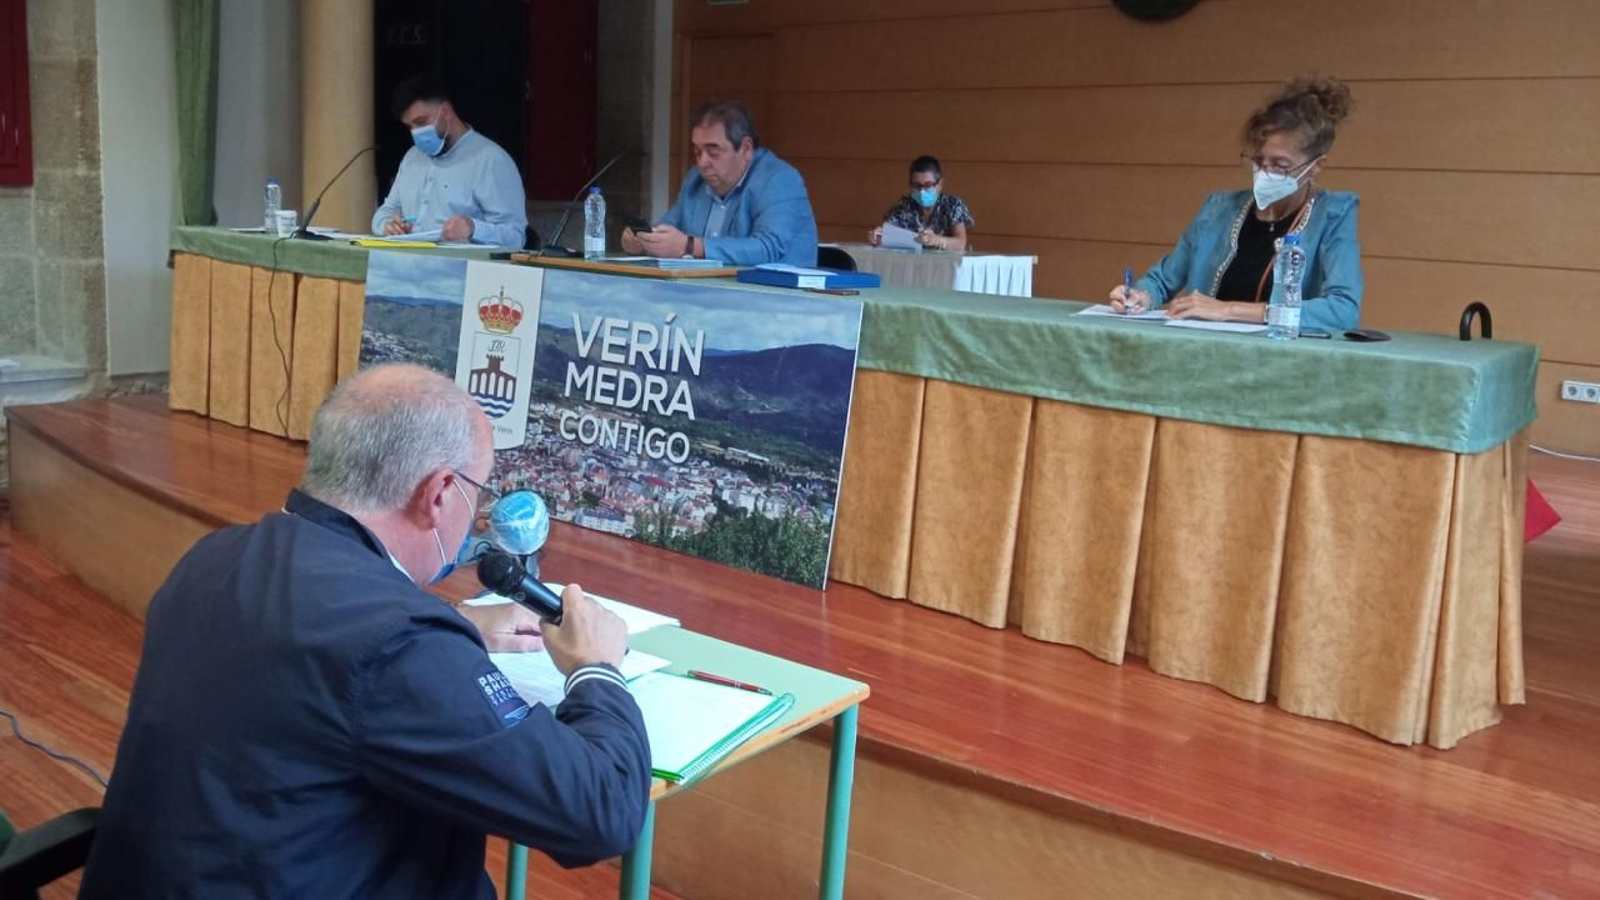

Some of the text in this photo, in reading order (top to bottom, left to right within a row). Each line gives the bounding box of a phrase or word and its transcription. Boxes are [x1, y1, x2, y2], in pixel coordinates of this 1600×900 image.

[572, 313, 705, 376] VERÍN
[564, 362, 695, 420] MEDRA
[559, 412, 690, 464] CONTIGO
